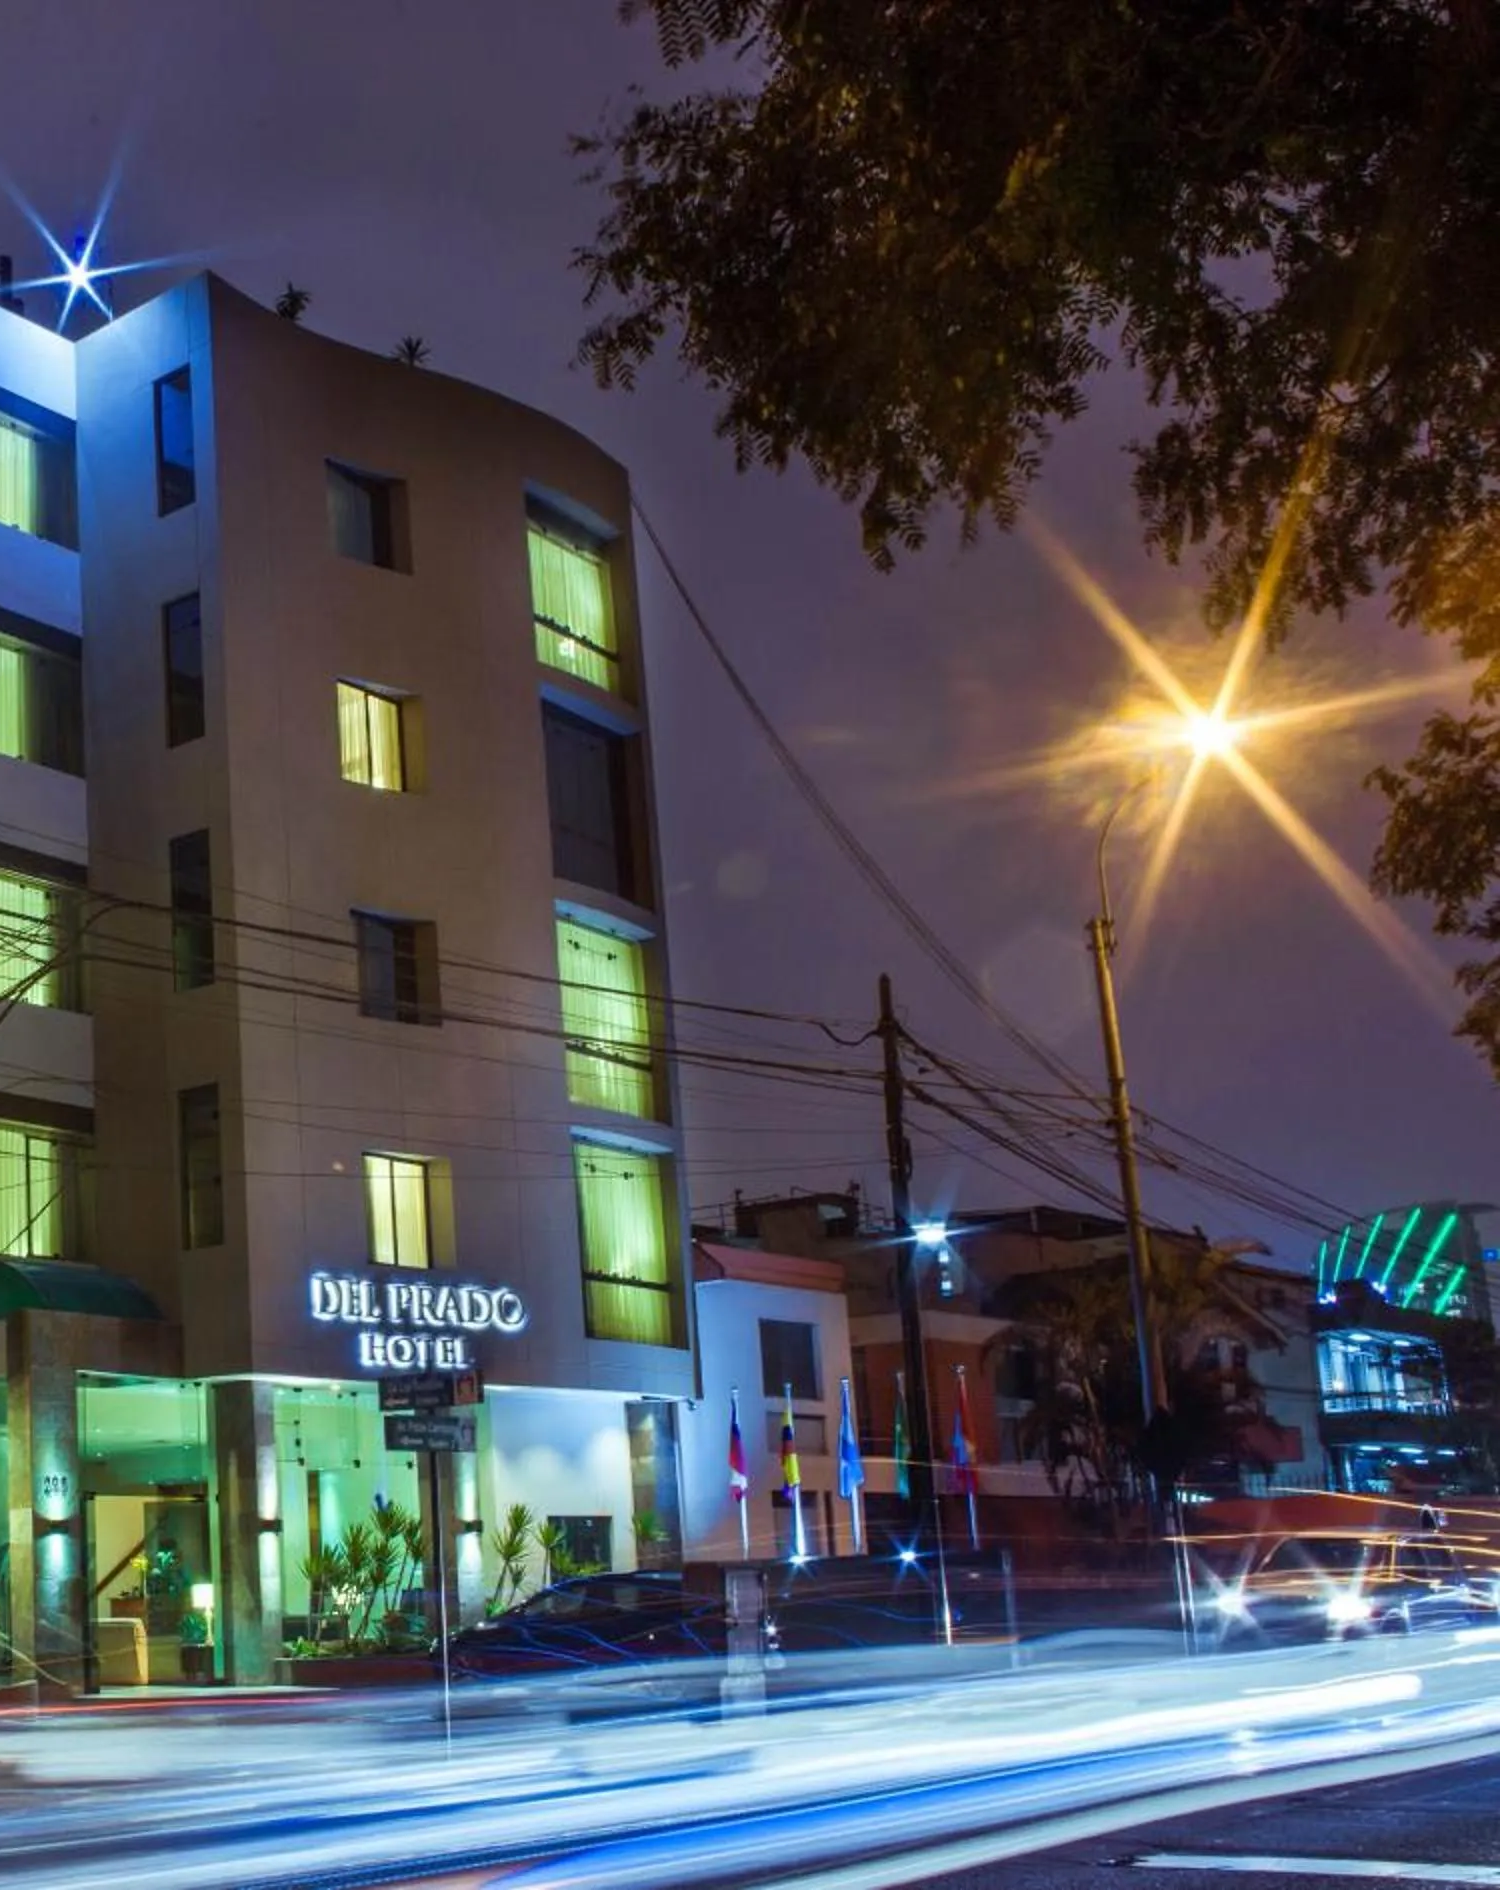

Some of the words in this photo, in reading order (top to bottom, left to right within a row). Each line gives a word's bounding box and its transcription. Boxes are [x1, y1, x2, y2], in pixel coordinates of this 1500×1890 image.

[310, 1272, 382, 1324] DEL
[387, 1282, 528, 1332] PRADO
[358, 1332, 474, 1370] HOTEL
